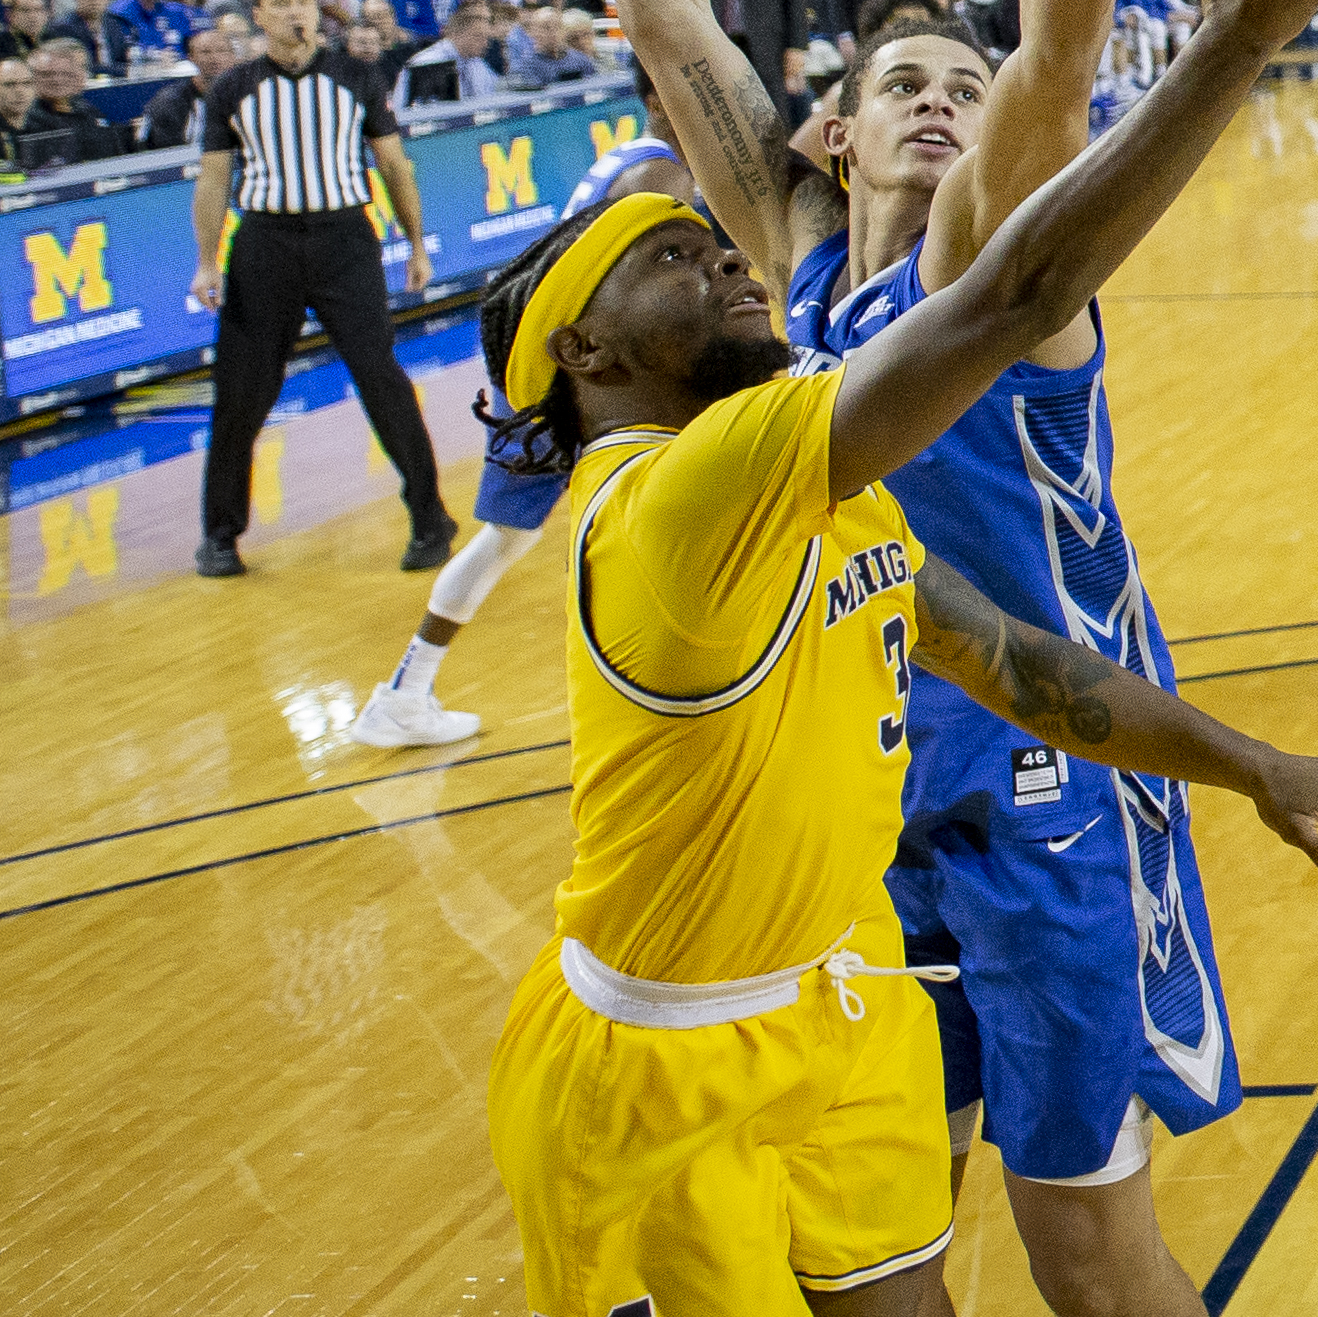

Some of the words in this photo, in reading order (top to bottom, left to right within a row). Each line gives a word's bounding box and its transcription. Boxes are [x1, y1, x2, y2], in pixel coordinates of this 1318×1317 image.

[480, 135, 539, 215] M
[25, 221, 112, 324] M
[878, 612, 911, 757] 3
[1021, 749, 1048, 767] 46
